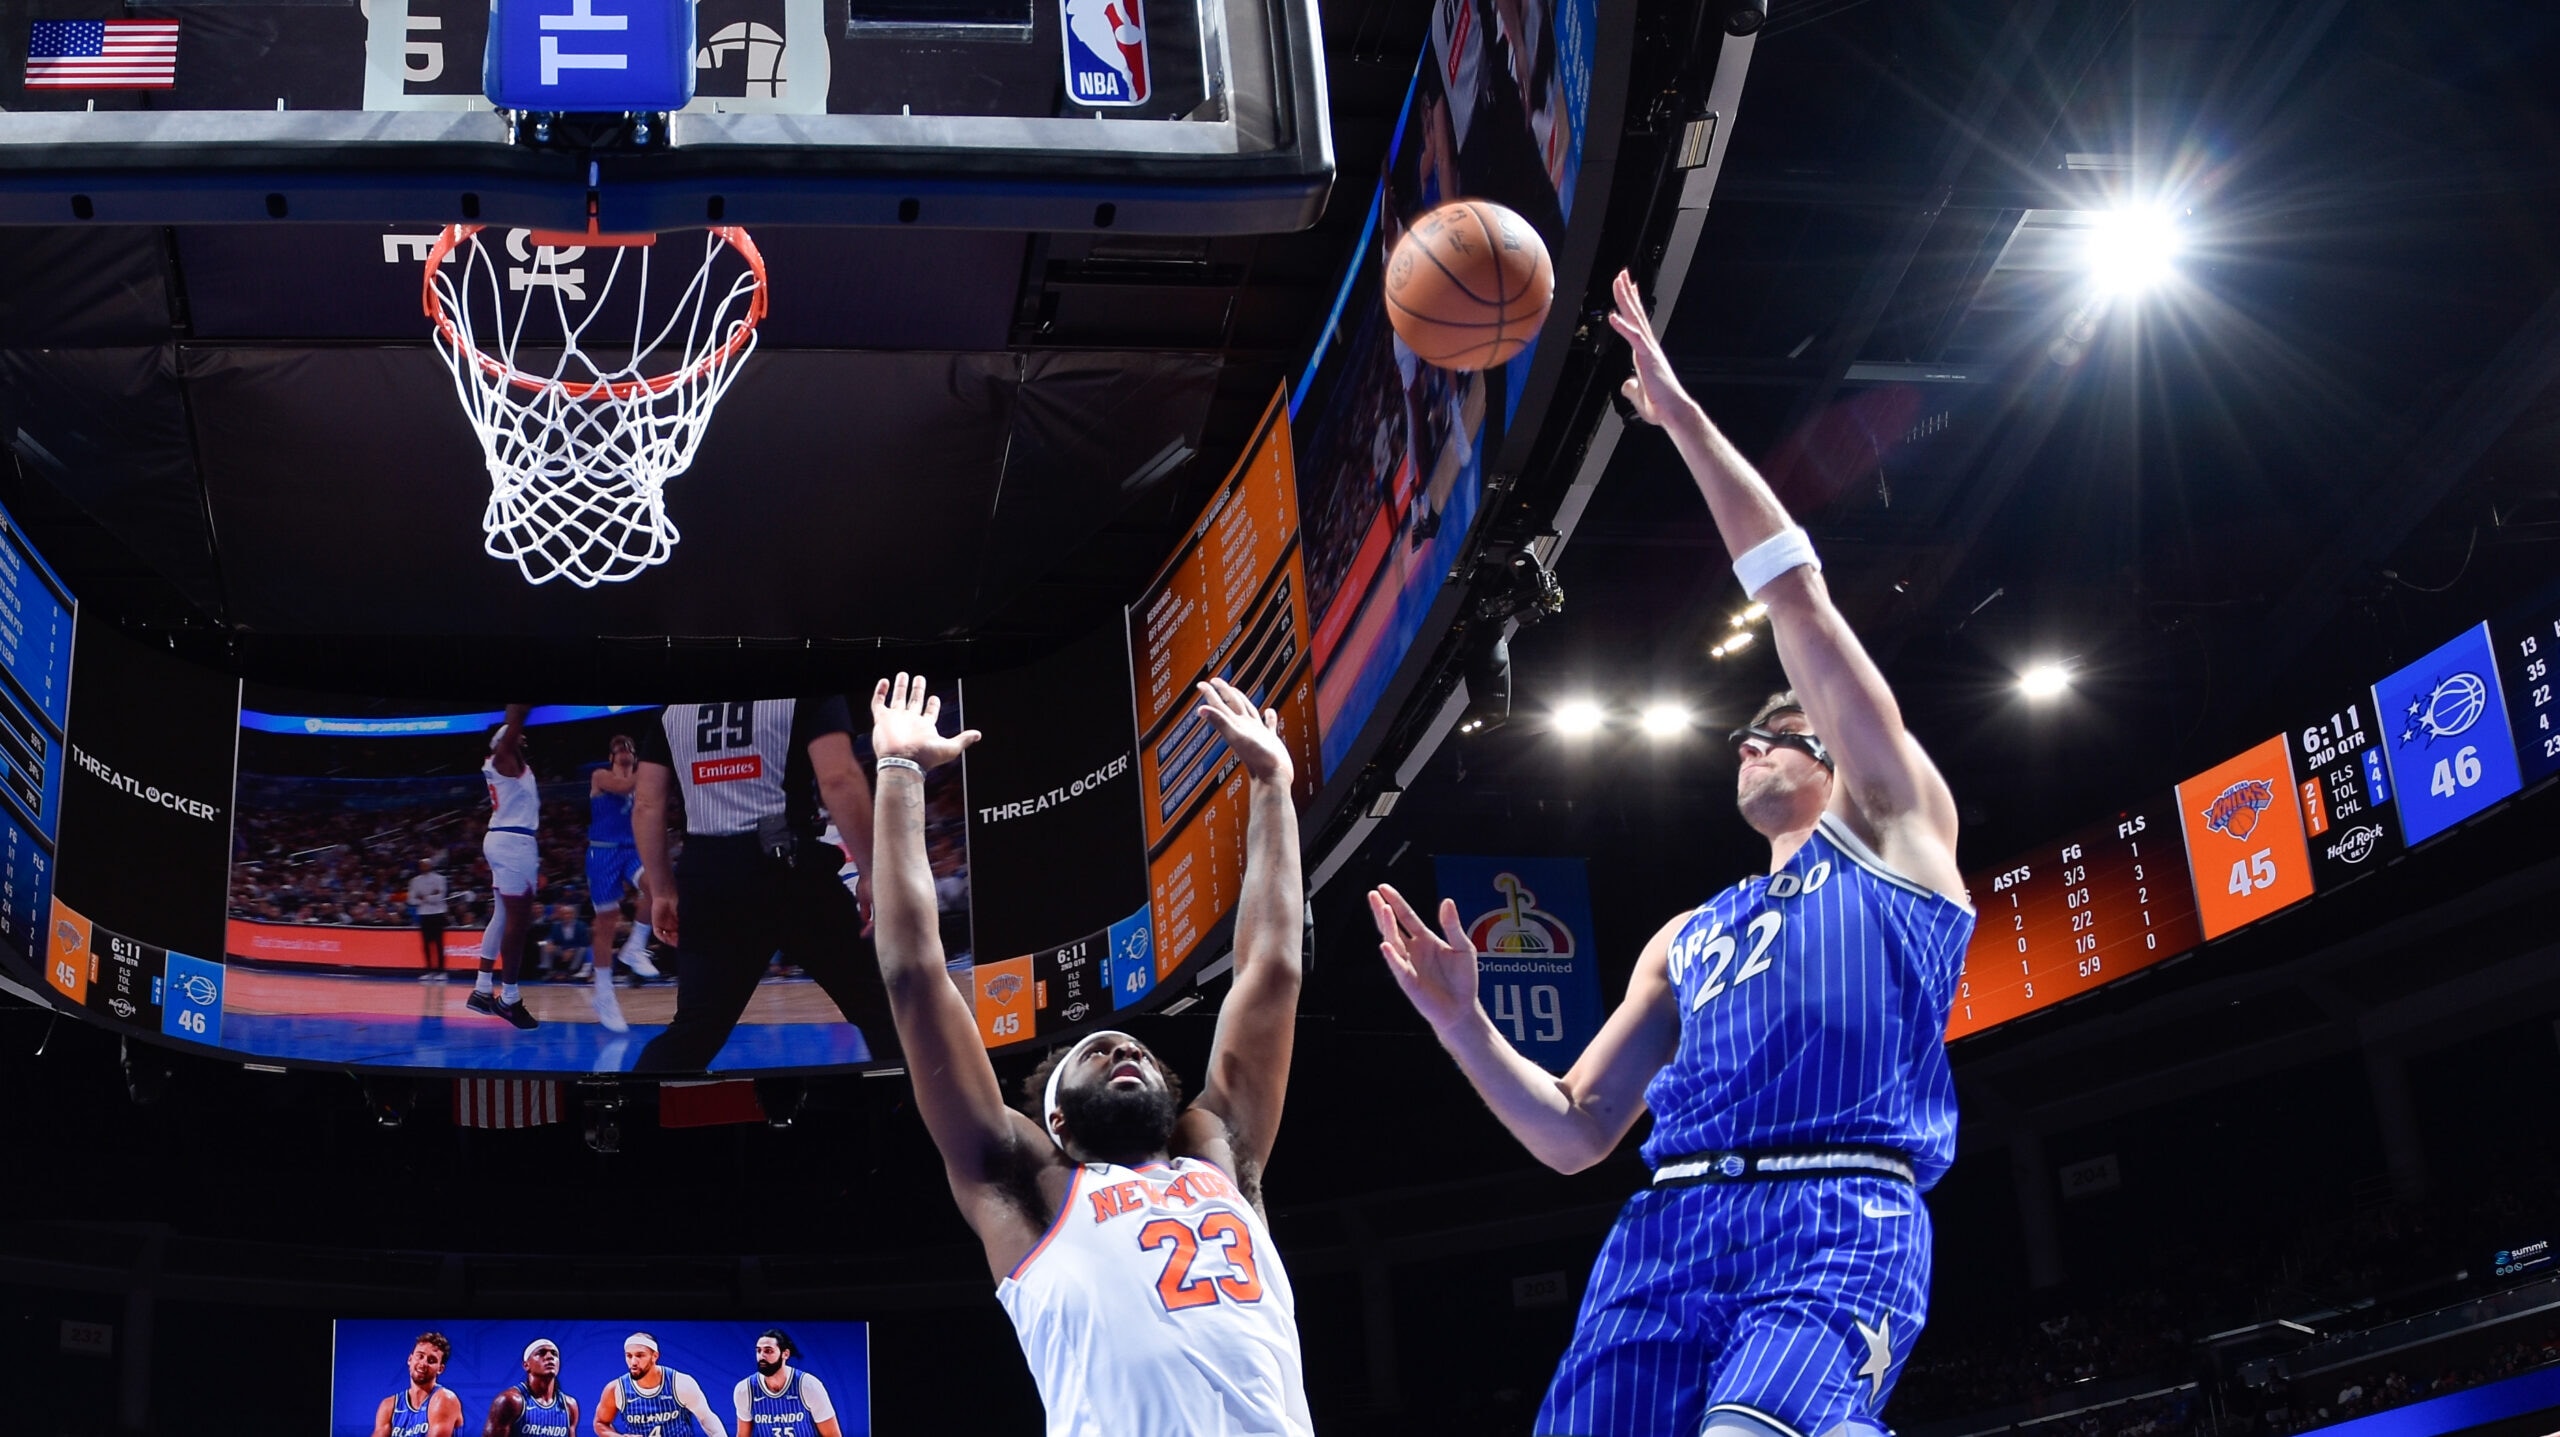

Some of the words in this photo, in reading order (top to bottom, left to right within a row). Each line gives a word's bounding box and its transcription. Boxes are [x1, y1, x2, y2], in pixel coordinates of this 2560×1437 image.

[1079, 72, 1119, 95] NBA
[2520, 636, 2537, 657] 13
[1151, 648, 1170, 679] ASSISTS
[2527, 659, 2546, 682] 35
[1152, 667, 1171, 697] BLOCKS
[1153, 687, 1171, 716] STEALS
[2532, 685, 2552, 707] 22
[697, 702, 754, 753] 29
[2303, 704, 2360, 753] 6:11
[2539, 713, 2549, 730] 4
[1204, 805, 1216, 826] PTS
[1227, 773, 1242, 801] REBS
[1297, 682, 1308, 705] FLS
[2308, 746, 2336, 770] 2ND
[2338, 730, 2366, 756] QTR
[2368, 750, 2378, 765] 4
[698, 762, 755, 778] Emirates
[2330, 764, 2354, 786] FLS
[2371, 766, 2382, 782] 4
[2430, 745, 2481, 798] 46
[72, 743, 215, 822] THREATLOCKER
[979, 755, 1128, 824] THREATLOCKER
[2305, 783, 2315, 798] 2
[2375, 784, 2384, 800] 1
[2211, 782, 2268, 824] KNICKS
[2308, 799, 2317, 815] 7
[2332, 786, 2358, 805] TOL
[2336, 799, 2362, 820] CHL
[2312, 816, 2320, 831] 1
[8, 827, 17, 843] FG
[32, 851, 44, 873] FLS
[2327, 836, 2355, 859] Hard
[2354, 823, 2384, 846] Rock
[2351, 847, 2365, 859] BET
[1994, 866, 2031, 893] ASTS
[2062, 844, 2082, 864] FG
[2118, 815, 2146, 839] FLS
[2011, 893, 2018, 907] 1
[2064, 865, 2086, 887] 3/3
[2131, 842, 2138, 857] 1
[2228, 847, 2277, 897] 45
[2015, 915, 2023, 931] 2
[2068, 888, 2090, 909] 0/3
[2135, 864, 2144, 880] 3
[2018, 937, 2027, 953] 0
[2072, 910, 2093, 932] 2/2
[2139, 887, 2148, 904] 2
[111, 937, 141, 961] 6:11
[1057, 942, 1087, 965] 6:11
[2022, 960, 2028, 975] 1
[2076, 933, 2096, 954] 1/6
[2144, 910, 2150, 925] 1
[119, 967, 131, 977] FLS
[1693, 911, 1782, 1013] 22
[1962, 982, 1970, 998] 2
[2025, 983, 2034, 999] 3
[2079, 956, 2101, 978] 5/9
[2146, 933, 2156, 950] 0
[55, 960, 76, 989] 45
[118, 975, 130, 986] TOL
[1068, 971, 1080, 980] FLS
[1068, 980, 1081, 989] TOL
[1126, 966, 1147, 993] 46
[117, 983, 130, 994] CHL
[1068, 988, 1081, 998] CHL
[178, 1009, 206, 1034] 46
[992, 1013, 1019, 1036] 45
[1494, 984, 1563, 1042] 49
[1965, 1005, 1972, 1020] 1
[2071, 1164, 2109, 1188] 204
[1089, 1180, 1169, 1224] NEW
[2511, 1240, 2549, 1257] summit
[1138, 1211, 1263, 1312] 23
